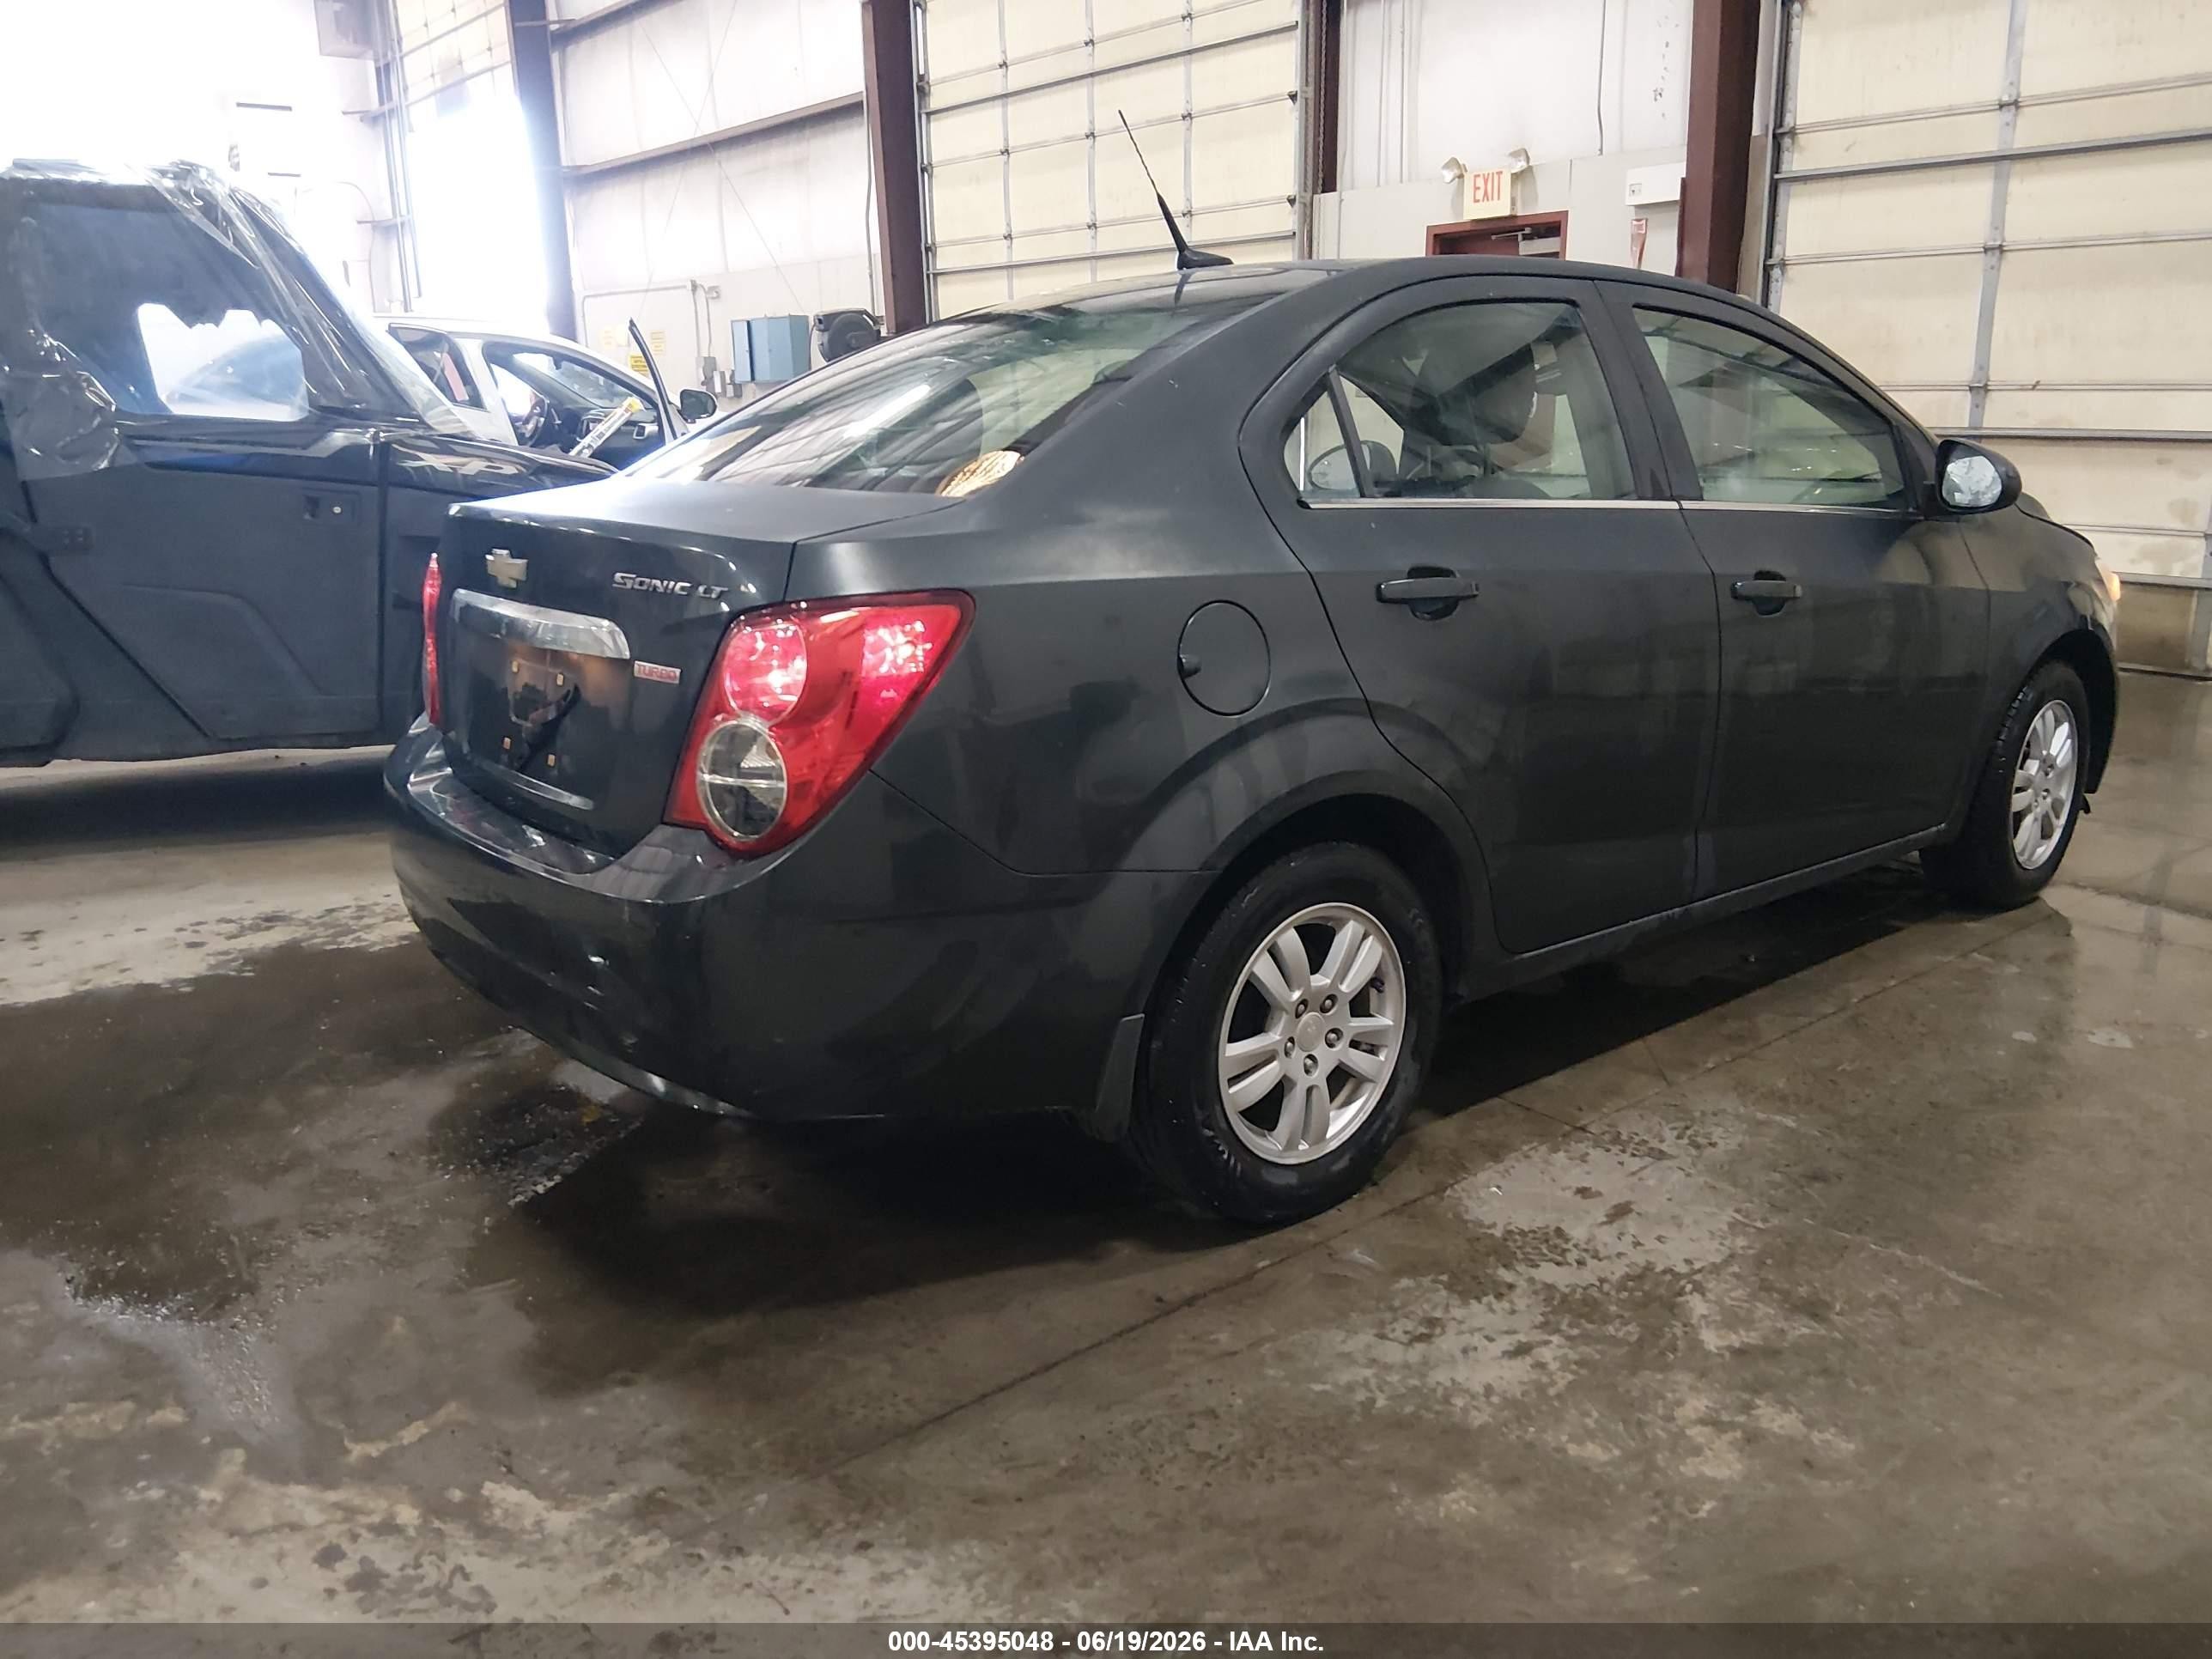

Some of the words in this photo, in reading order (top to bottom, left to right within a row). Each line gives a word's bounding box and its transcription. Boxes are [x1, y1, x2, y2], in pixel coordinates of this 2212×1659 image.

[1473, 170, 1504, 204] EXIT
[612, 572, 693, 595] SONIC
[697, 585, 729, 599] LT
[636, 662, 678, 683] TURBO
